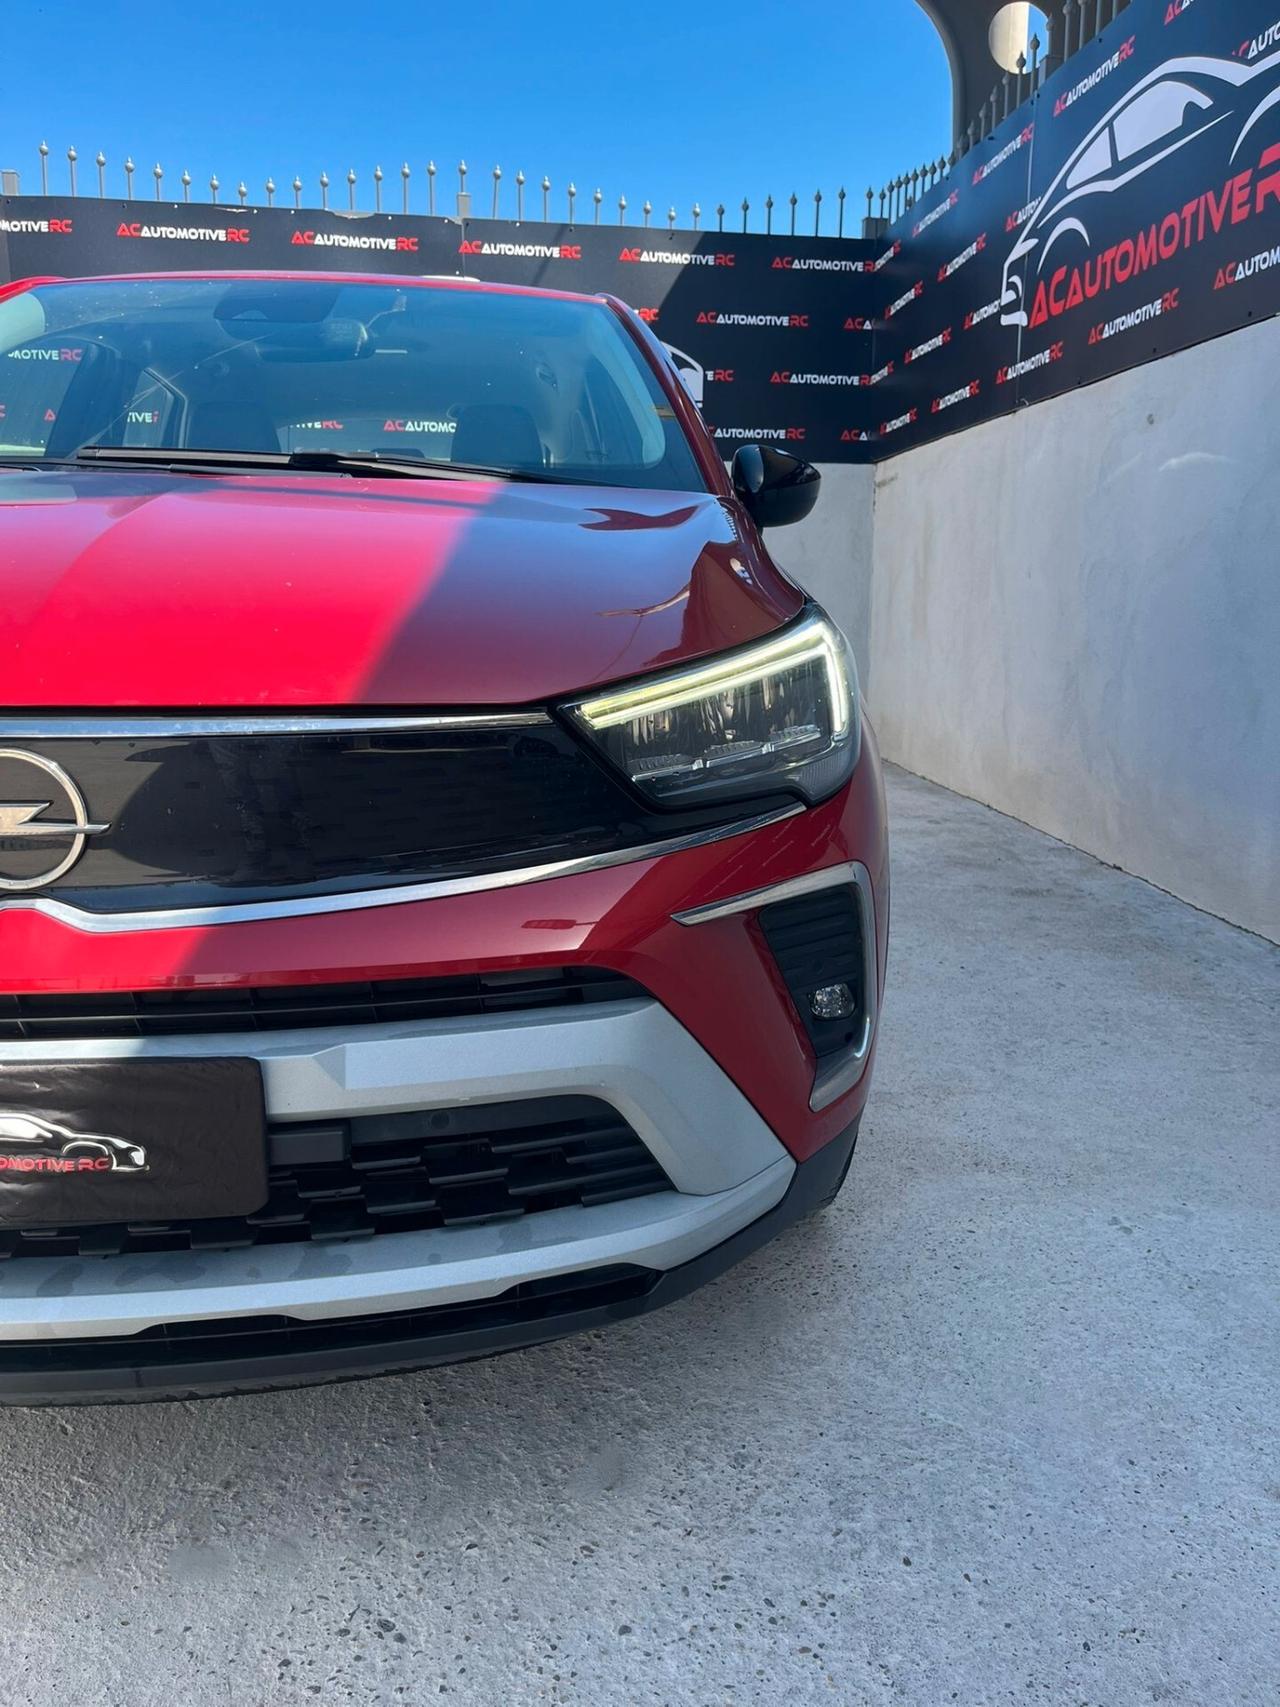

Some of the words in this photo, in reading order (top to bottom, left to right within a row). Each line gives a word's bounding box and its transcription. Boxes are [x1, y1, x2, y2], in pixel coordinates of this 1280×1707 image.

[1053, 35, 1136, 117] ACAUTOMOTIVERC
[117, 223, 250, 242] ACAUTOMOTIVERC
[291, 231, 418, 250] ACAUTOMOTIVERC
[459, 240, 581, 259] ACAUTOMOTIVERC
[619, 247, 735, 266] ACAUTOMOTIVERC
[697, 312, 808, 327] ACAUTOMOTIVERC
[1088, 288, 1179, 344] ACAUTOMOTIVERC
[996, 342, 1063, 384] ACAUTOMOTIVERC
